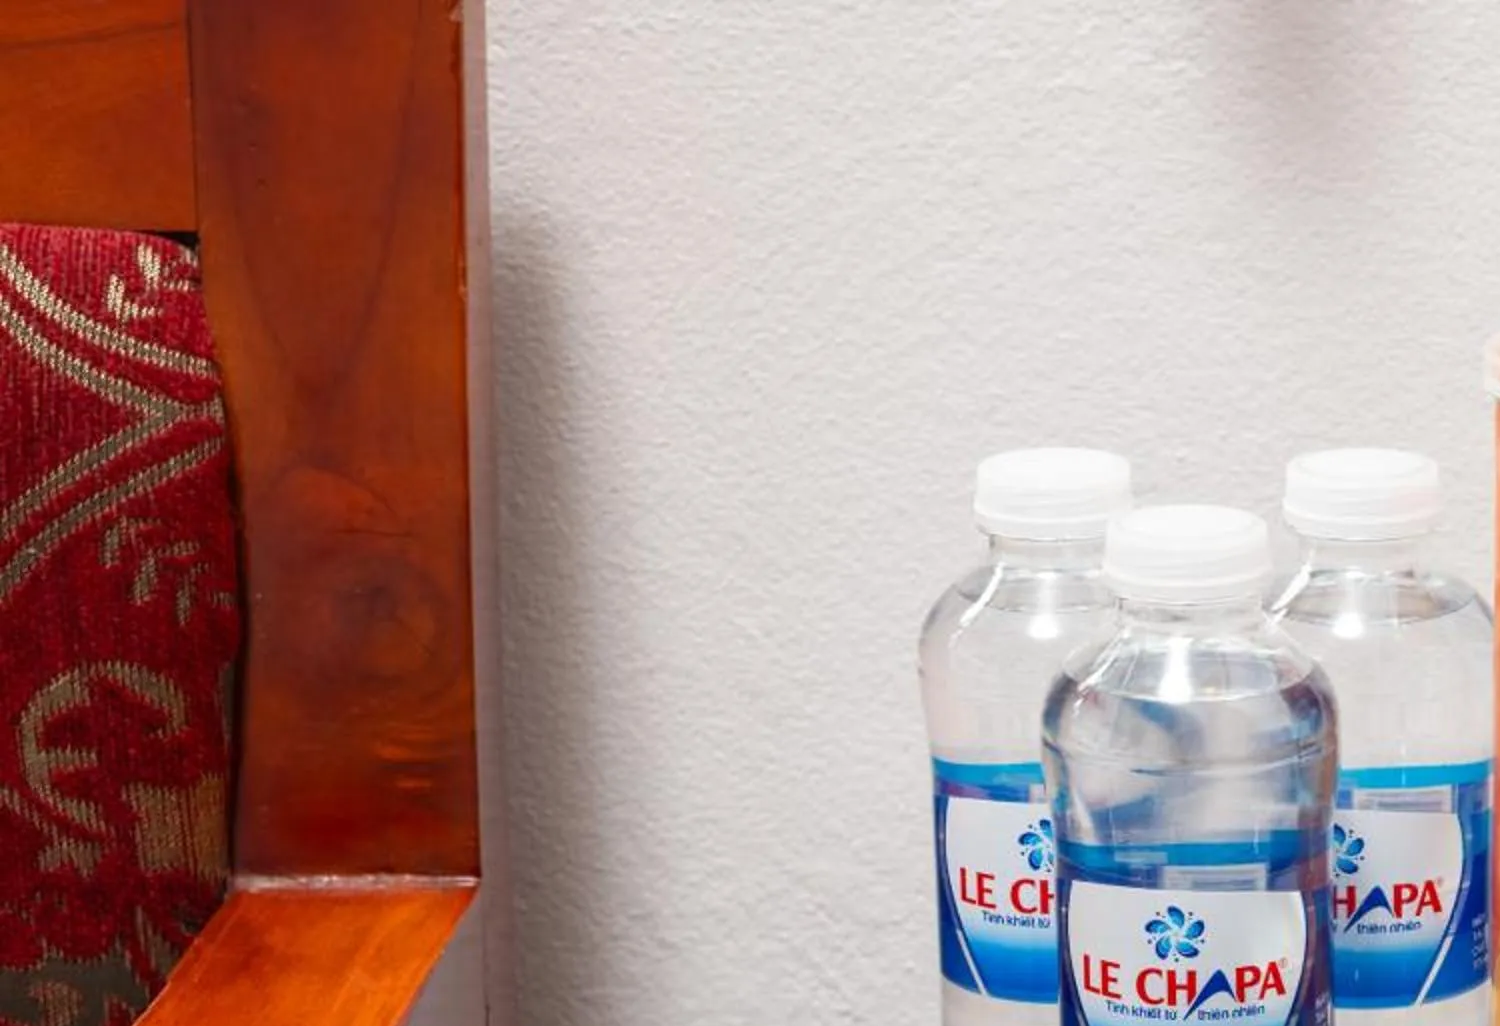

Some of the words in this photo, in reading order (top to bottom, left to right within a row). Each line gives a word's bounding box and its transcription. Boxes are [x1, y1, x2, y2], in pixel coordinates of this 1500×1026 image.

[959, 867, 997, 909] LE
[1332, 879, 1442, 933] HAPA
[1083, 954, 1122, 999] LE
